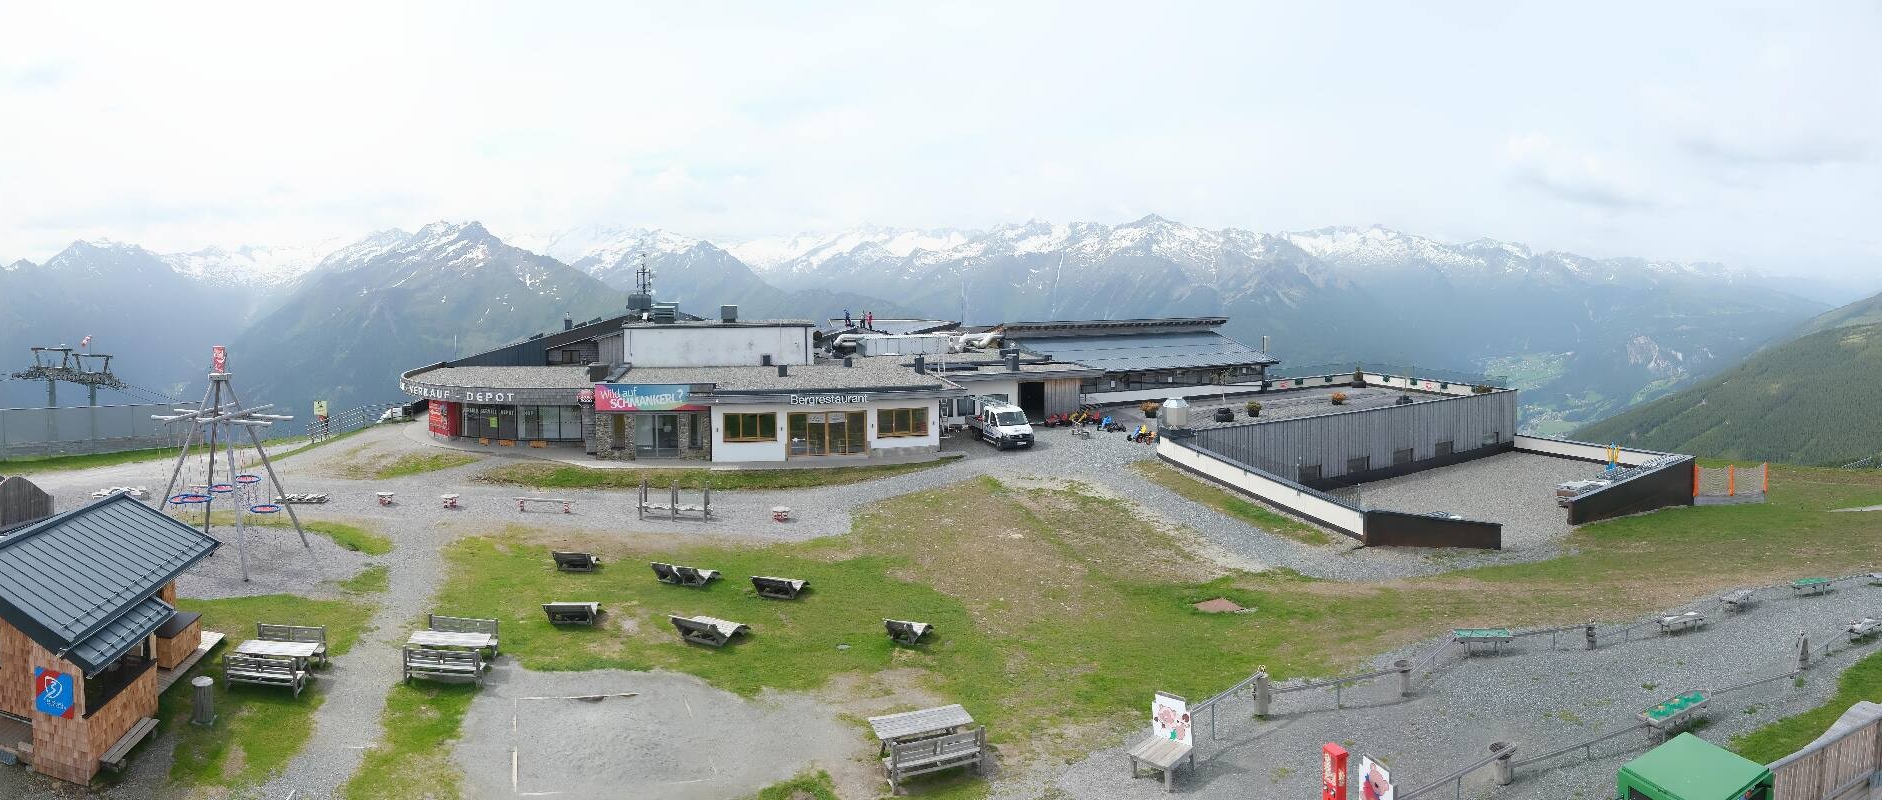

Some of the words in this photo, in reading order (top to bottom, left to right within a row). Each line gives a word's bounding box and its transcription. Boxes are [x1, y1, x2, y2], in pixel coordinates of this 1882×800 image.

[409, 385, 450, 398] VERKAUF
[466, 392, 515, 401] DEPOT
[599, 388, 621, 399] Wild
[622, 386, 637, 397] auf
[790, 394, 868, 406] Bergrestaurant
